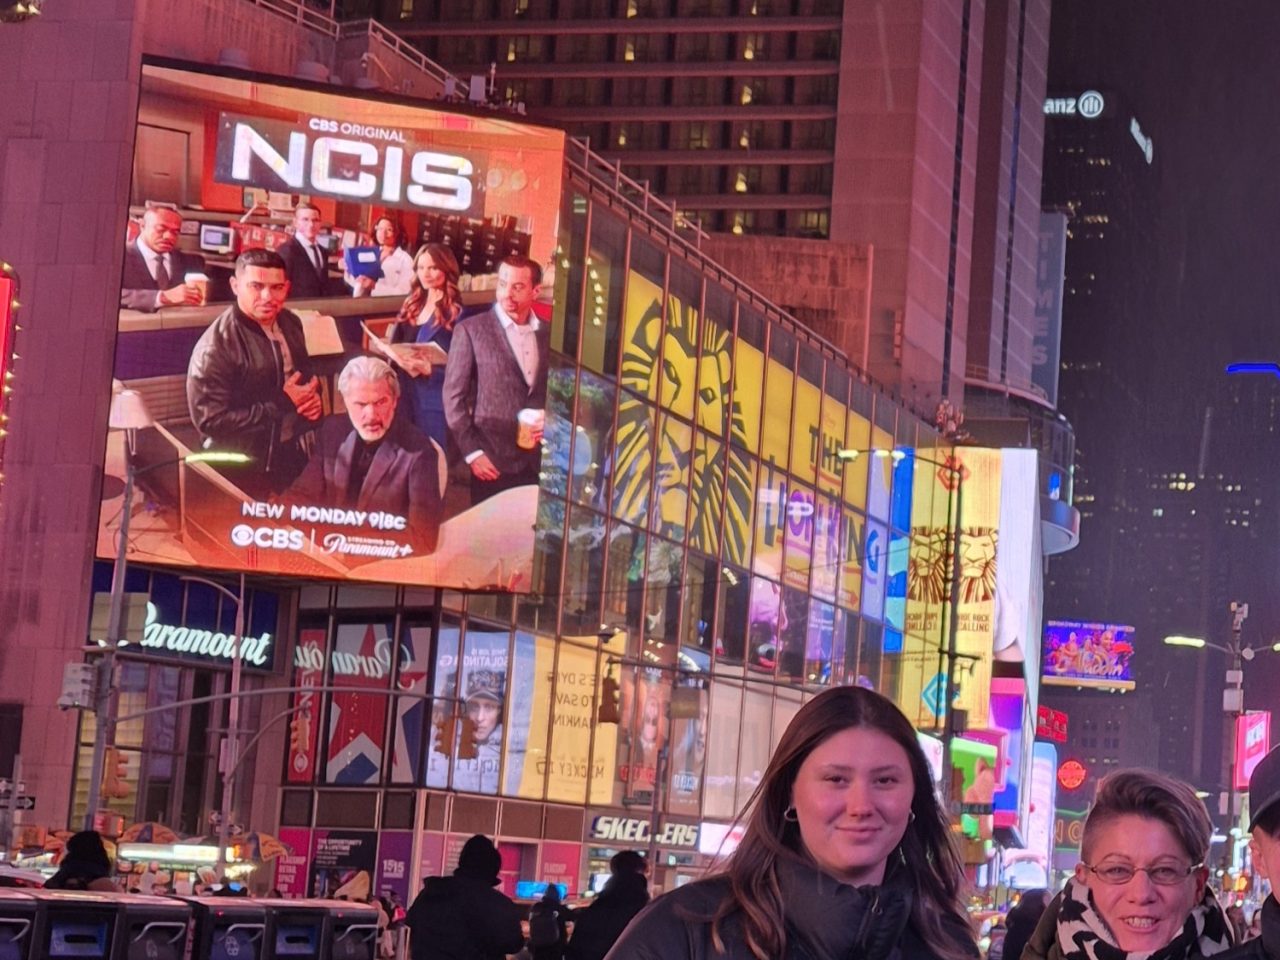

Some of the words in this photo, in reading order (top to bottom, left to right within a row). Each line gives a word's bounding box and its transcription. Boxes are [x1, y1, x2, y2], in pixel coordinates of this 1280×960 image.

[309, 118, 338, 133] CBS
[339, 121, 407, 144] ORIGINAL
[231, 122, 473, 211] NCIS
[809, 425, 843, 478] THE
[242, 501, 285, 519] NEW
[290, 504, 367, 526] MONDAY
[254, 527, 305, 550] CBS
[98, 601, 272, 666] aramount
[592, 815, 699, 847] SKECERS
